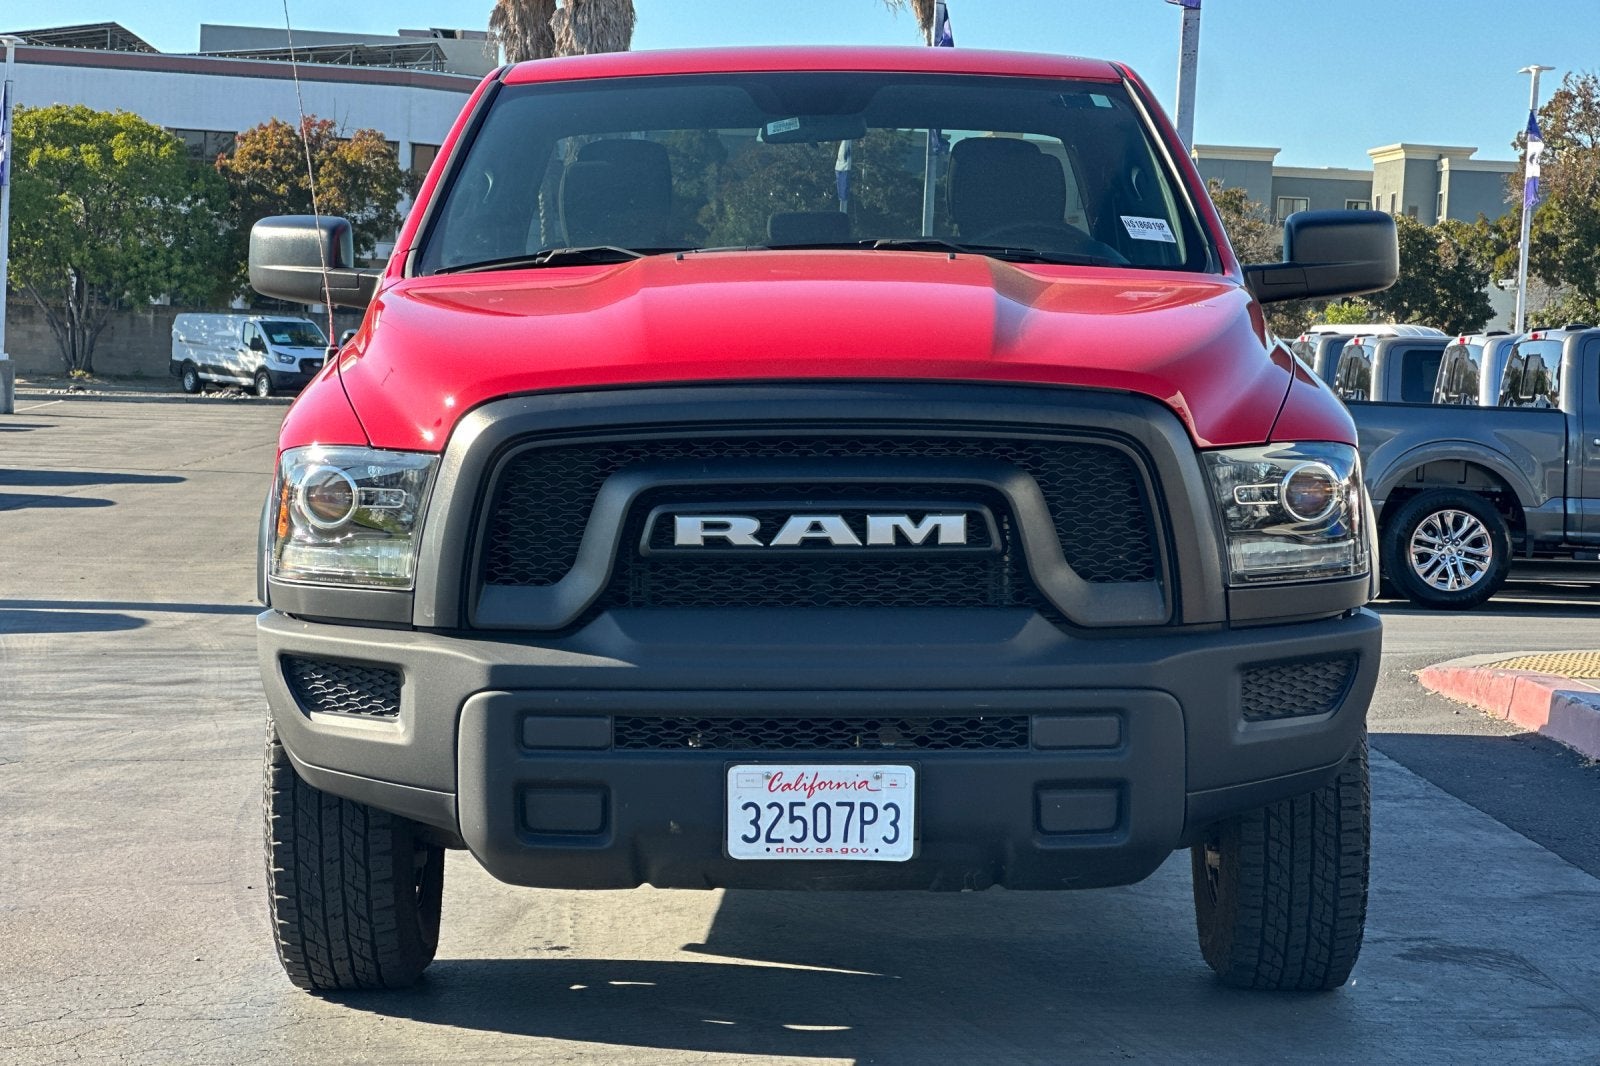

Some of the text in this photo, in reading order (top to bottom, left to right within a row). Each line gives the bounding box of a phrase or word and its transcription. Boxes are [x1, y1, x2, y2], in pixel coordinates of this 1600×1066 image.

[674, 514, 967, 547] RAM
[768, 771, 882, 799] California
[741, 801, 901, 844] 32507P3
[775, 846, 869, 855] dmv.ca.gov
